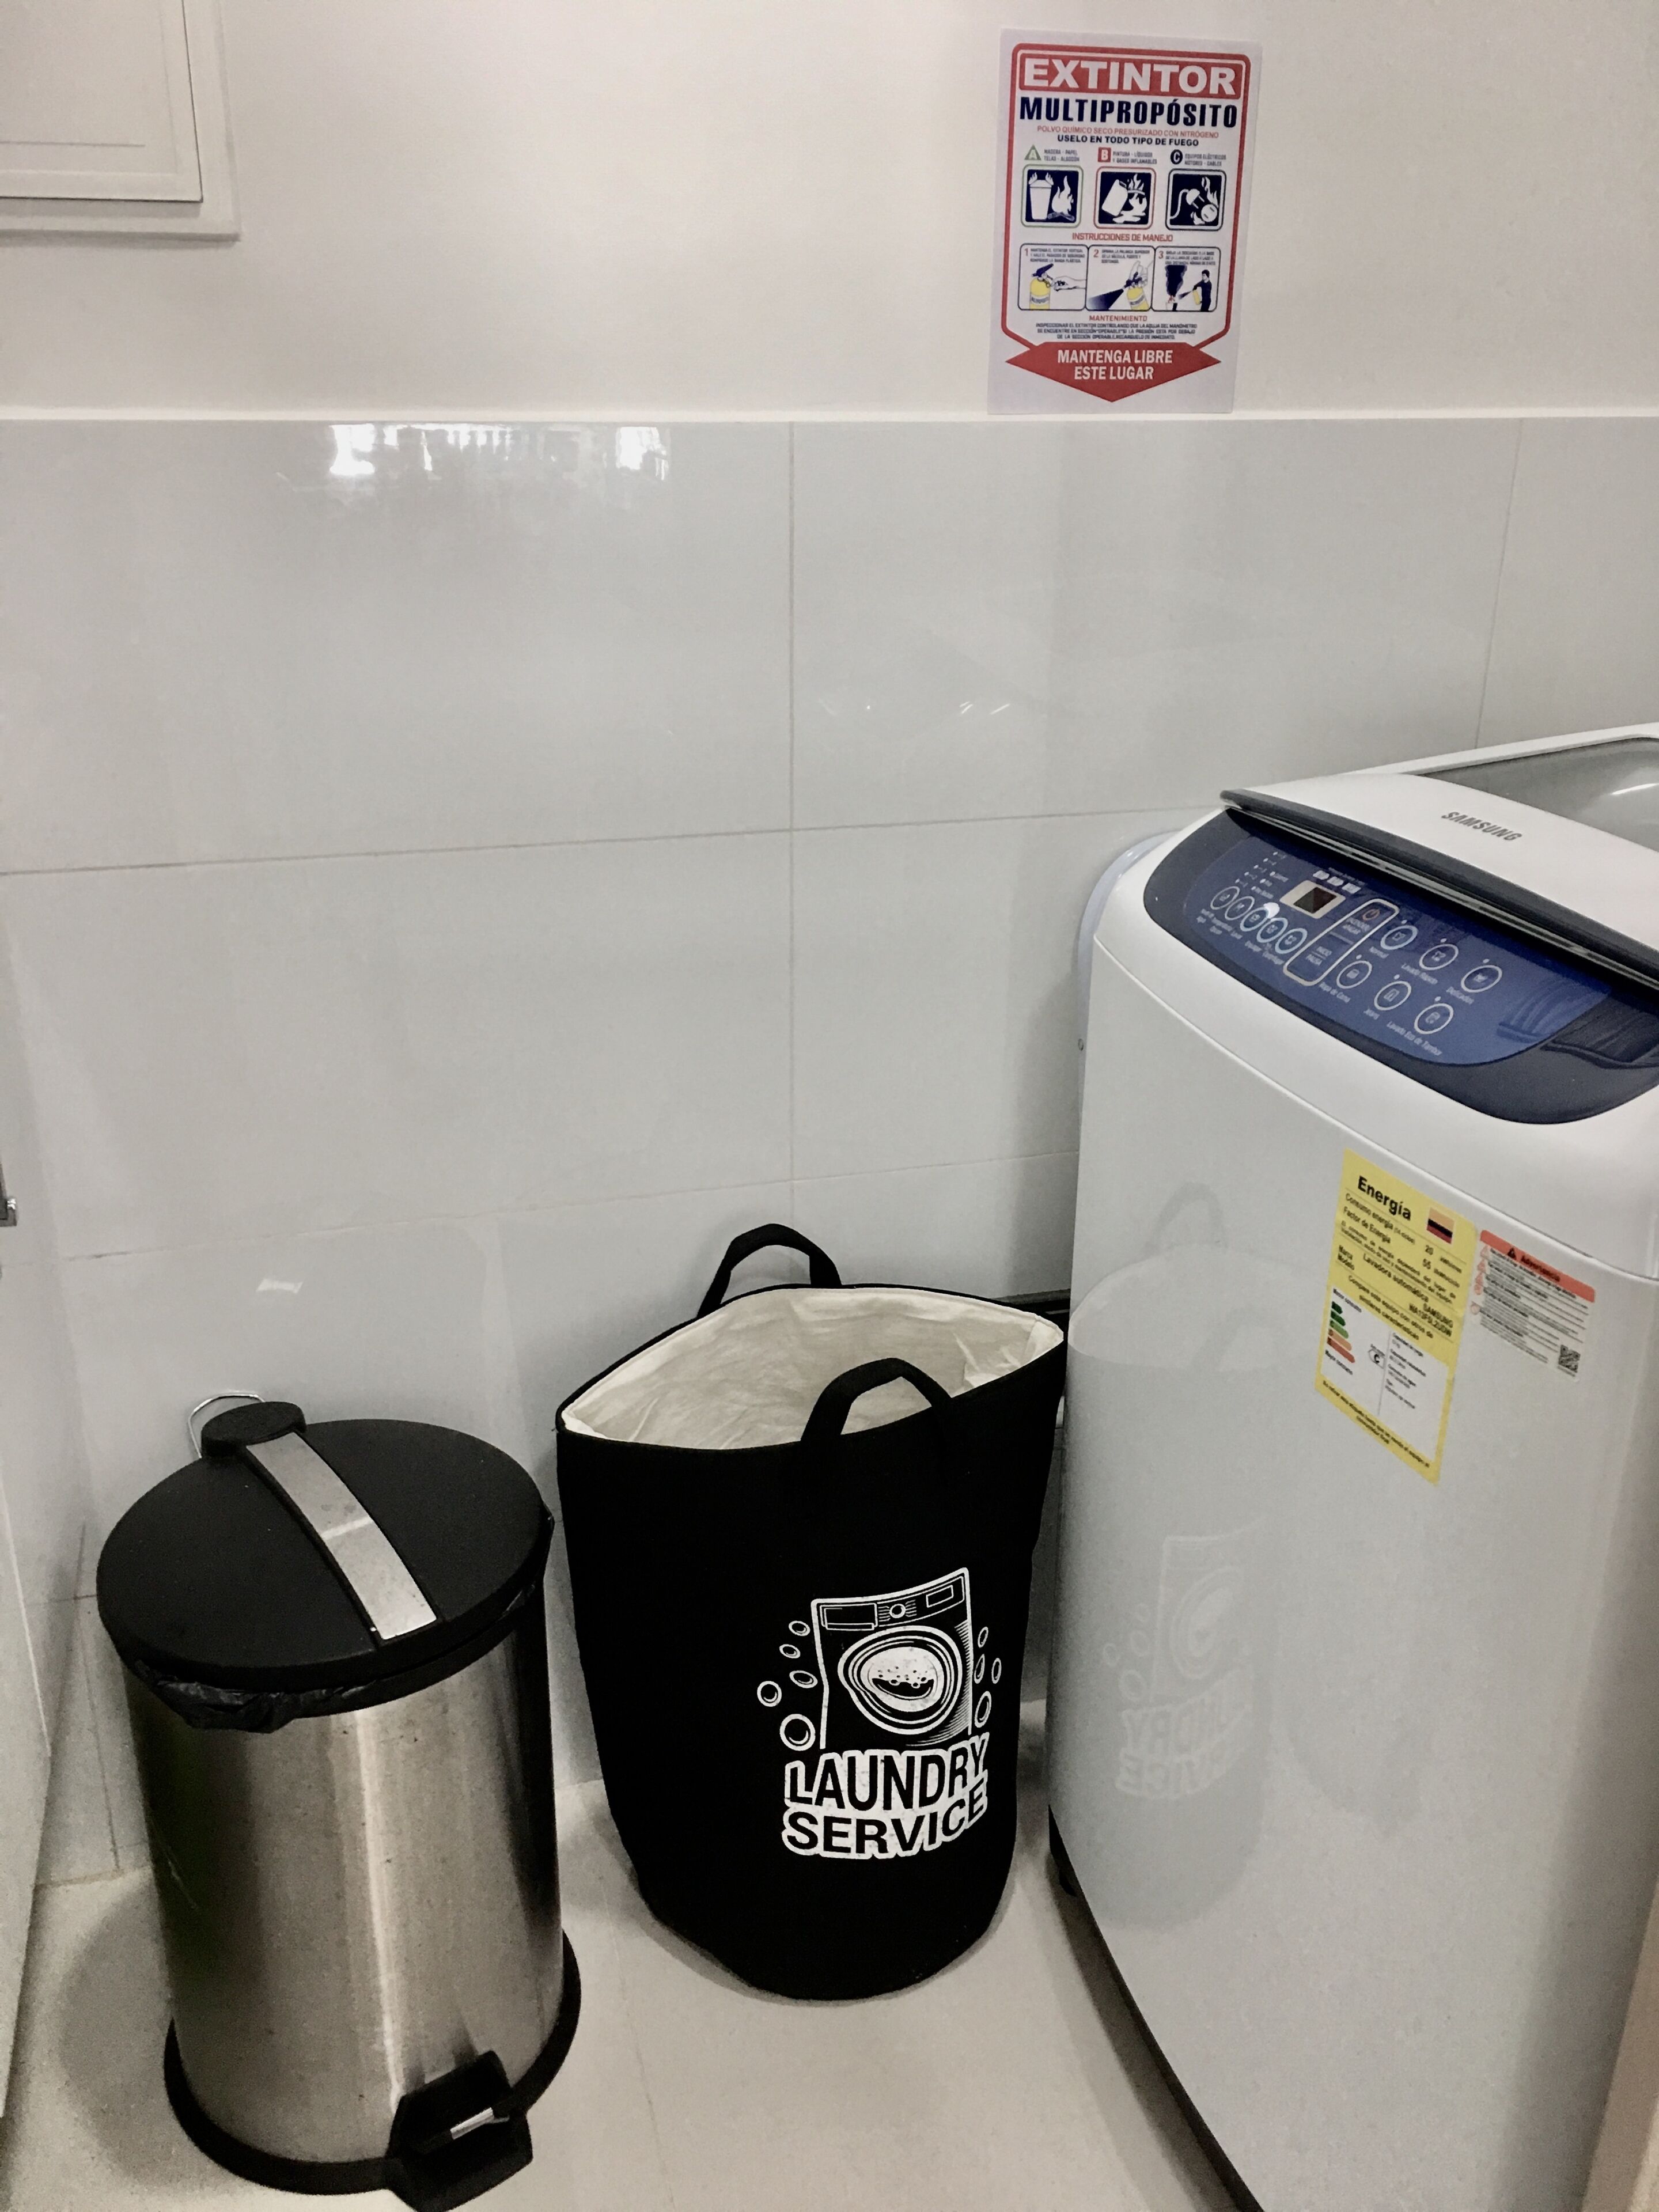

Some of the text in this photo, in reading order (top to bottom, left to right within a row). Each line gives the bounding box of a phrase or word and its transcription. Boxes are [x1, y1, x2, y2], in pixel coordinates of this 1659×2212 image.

[1023, 58, 1236, 95] EXTINTOR
[1020, 96, 1237, 128] MULTIPROPÓSITO
[1058, 134, 1088, 143] USELO
[1105, 136, 1130, 144] TODO
[1169, 138, 1199, 146] FUEGO
[1062, 126, 1092, 134] QUÍMICO
[1114, 128, 1162, 136] PRESURIZADO
[1180, 130, 1219, 138] NITRÓGENO
[1101, 149, 1108, 160] B
[1173, 151, 1181, 163] C
[1072, 232, 1173, 242] INSTRUCCIONES DE MANEJO
[1024, 248, 1028, 256] 1
[1093, 249, 1099, 258] 2
[1158, 250, 1164, 259] 3
[1058, 350, 1173, 363] MANTENGA LIBRE
[1074, 366, 1154, 381] ESTE LUGAR
[1441, 812, 1522, 841] SAMSUNG
[1357, 1176, 1412, 1224] Energía
[1345, 1192, 1372, 1215] Consumo
[1372, 1210, 1393, 1232] energía
[1343, 1206, 1361, 1224] Factor
[1361, 1218, 1368, 1229] de
[1369, 1224, 1391, 1245] Energía
[1338, 1244, 1353, 1260] Marca
[1337, 1253, 1355, 1270] Modelo
[1363, 1253, 1391, 1278] Lavadora
[1392, 1272, 1429, 1303] automática
[1422, 1303, 1453, 1329] SAMSUNG
[1373, 1351, 1380, 1365] C
[786, 1733, 989, 1810] LAUNDRY
[783, 1775, 987, 1858] SERVICE
